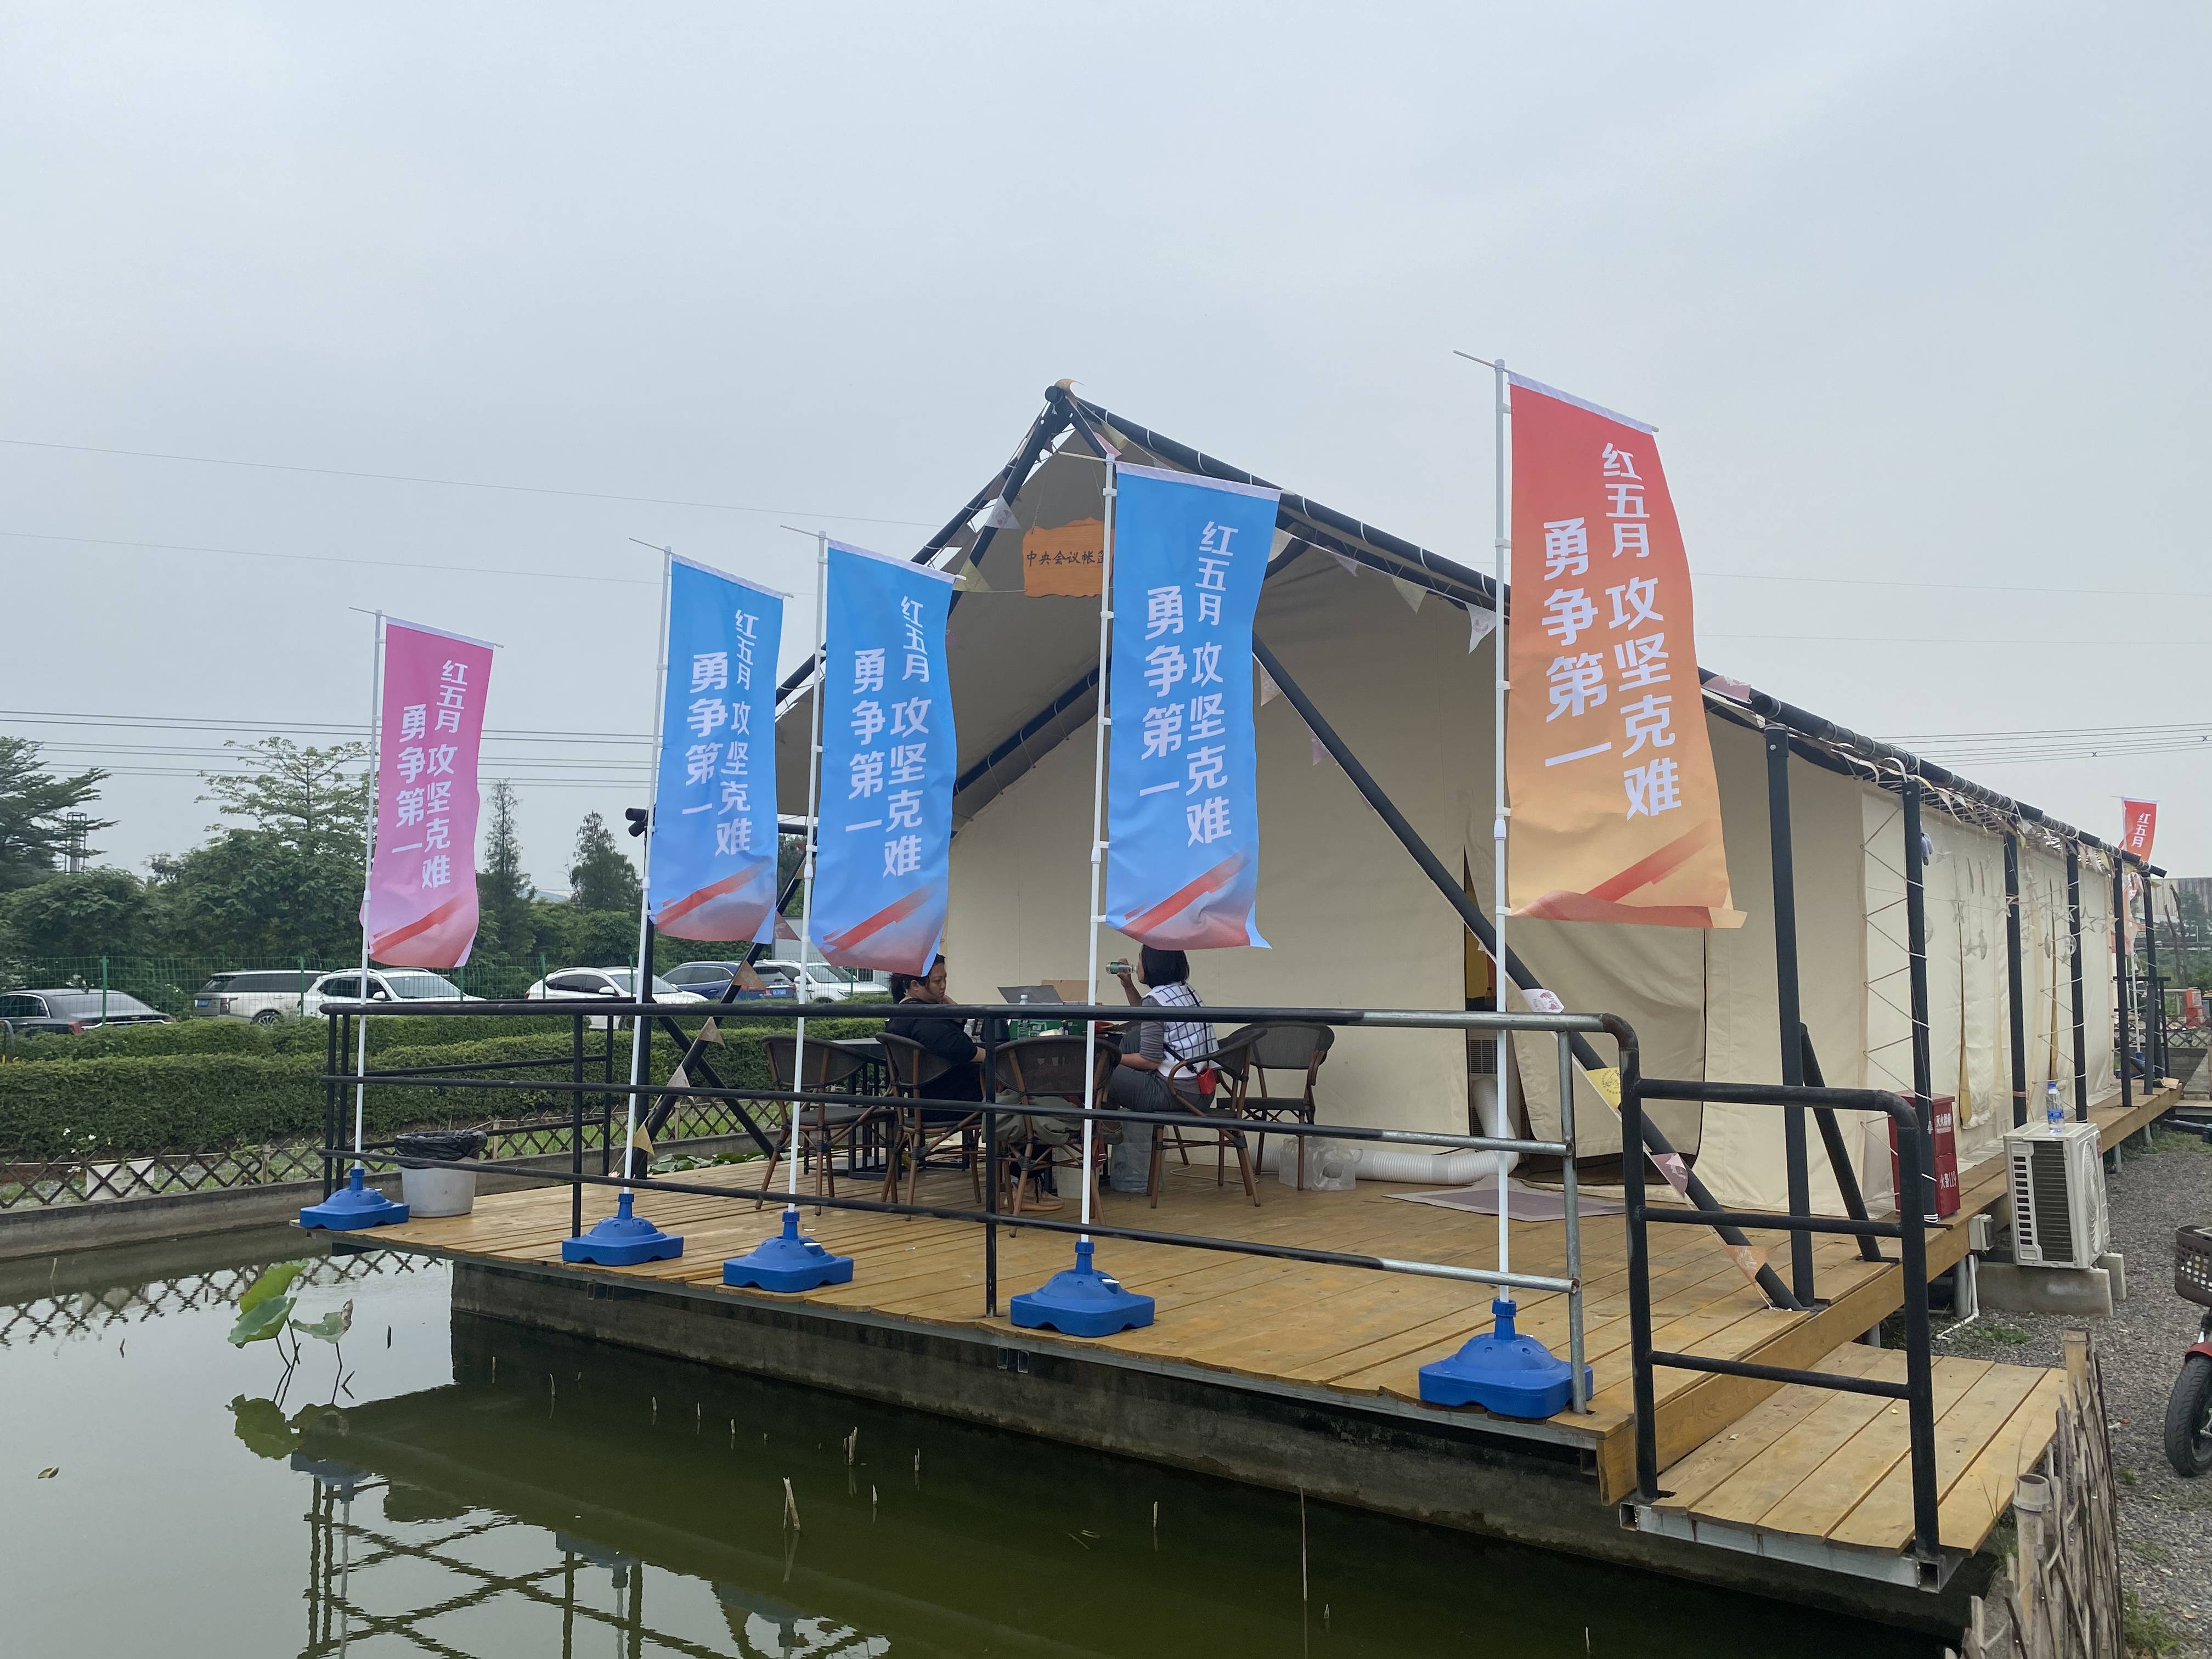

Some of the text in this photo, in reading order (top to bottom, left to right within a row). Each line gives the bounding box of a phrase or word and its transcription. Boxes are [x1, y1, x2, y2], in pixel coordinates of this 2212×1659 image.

[682, 652, 729, 815] 勇争第一
[715, 610, 759, 856] 红五月 攻坚克难
[846, 648, 886, 832] 勇争第一
[883, 596, 931, 878] 红五月 攻坚克难
[1139, 586, 1188, 797] 勇争第一
[1186, 521, 1238, 847] 红五月 攻坚克难
[1542, 517, 1612, 766] 勇争第一
[1602, 443, 1681, 821] 红五月 攻坚克难
[392, 704, 426, 854] 勇争第一
[421, 660, 467, 889] 红五月 攻坚克难
[2131, 813, 2151, 848] 红五月
